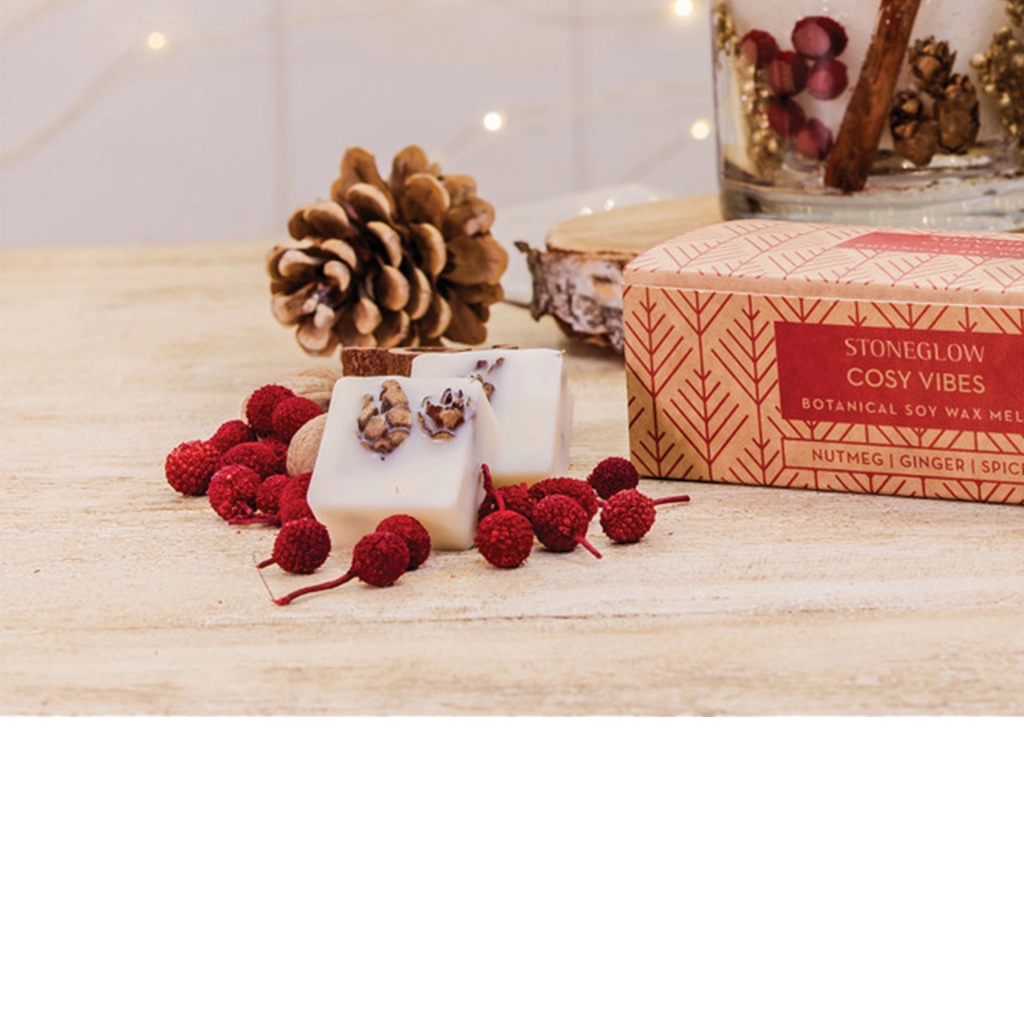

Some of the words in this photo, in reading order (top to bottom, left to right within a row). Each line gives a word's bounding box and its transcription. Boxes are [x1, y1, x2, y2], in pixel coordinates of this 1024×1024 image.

[844, 338, 985, 363] STONEGLOW
[847, 367, 912, 390] COSY
[919, 371, 985, 394] VIBES
[801, 397, 898, 415] BOTANICAL
[905, 404, 937, 417] SOY
[945, 407, 983, 420] WAX
[812, 449, 884, 466] NUTMEG
[900, 454, 965, 473] GINGER
